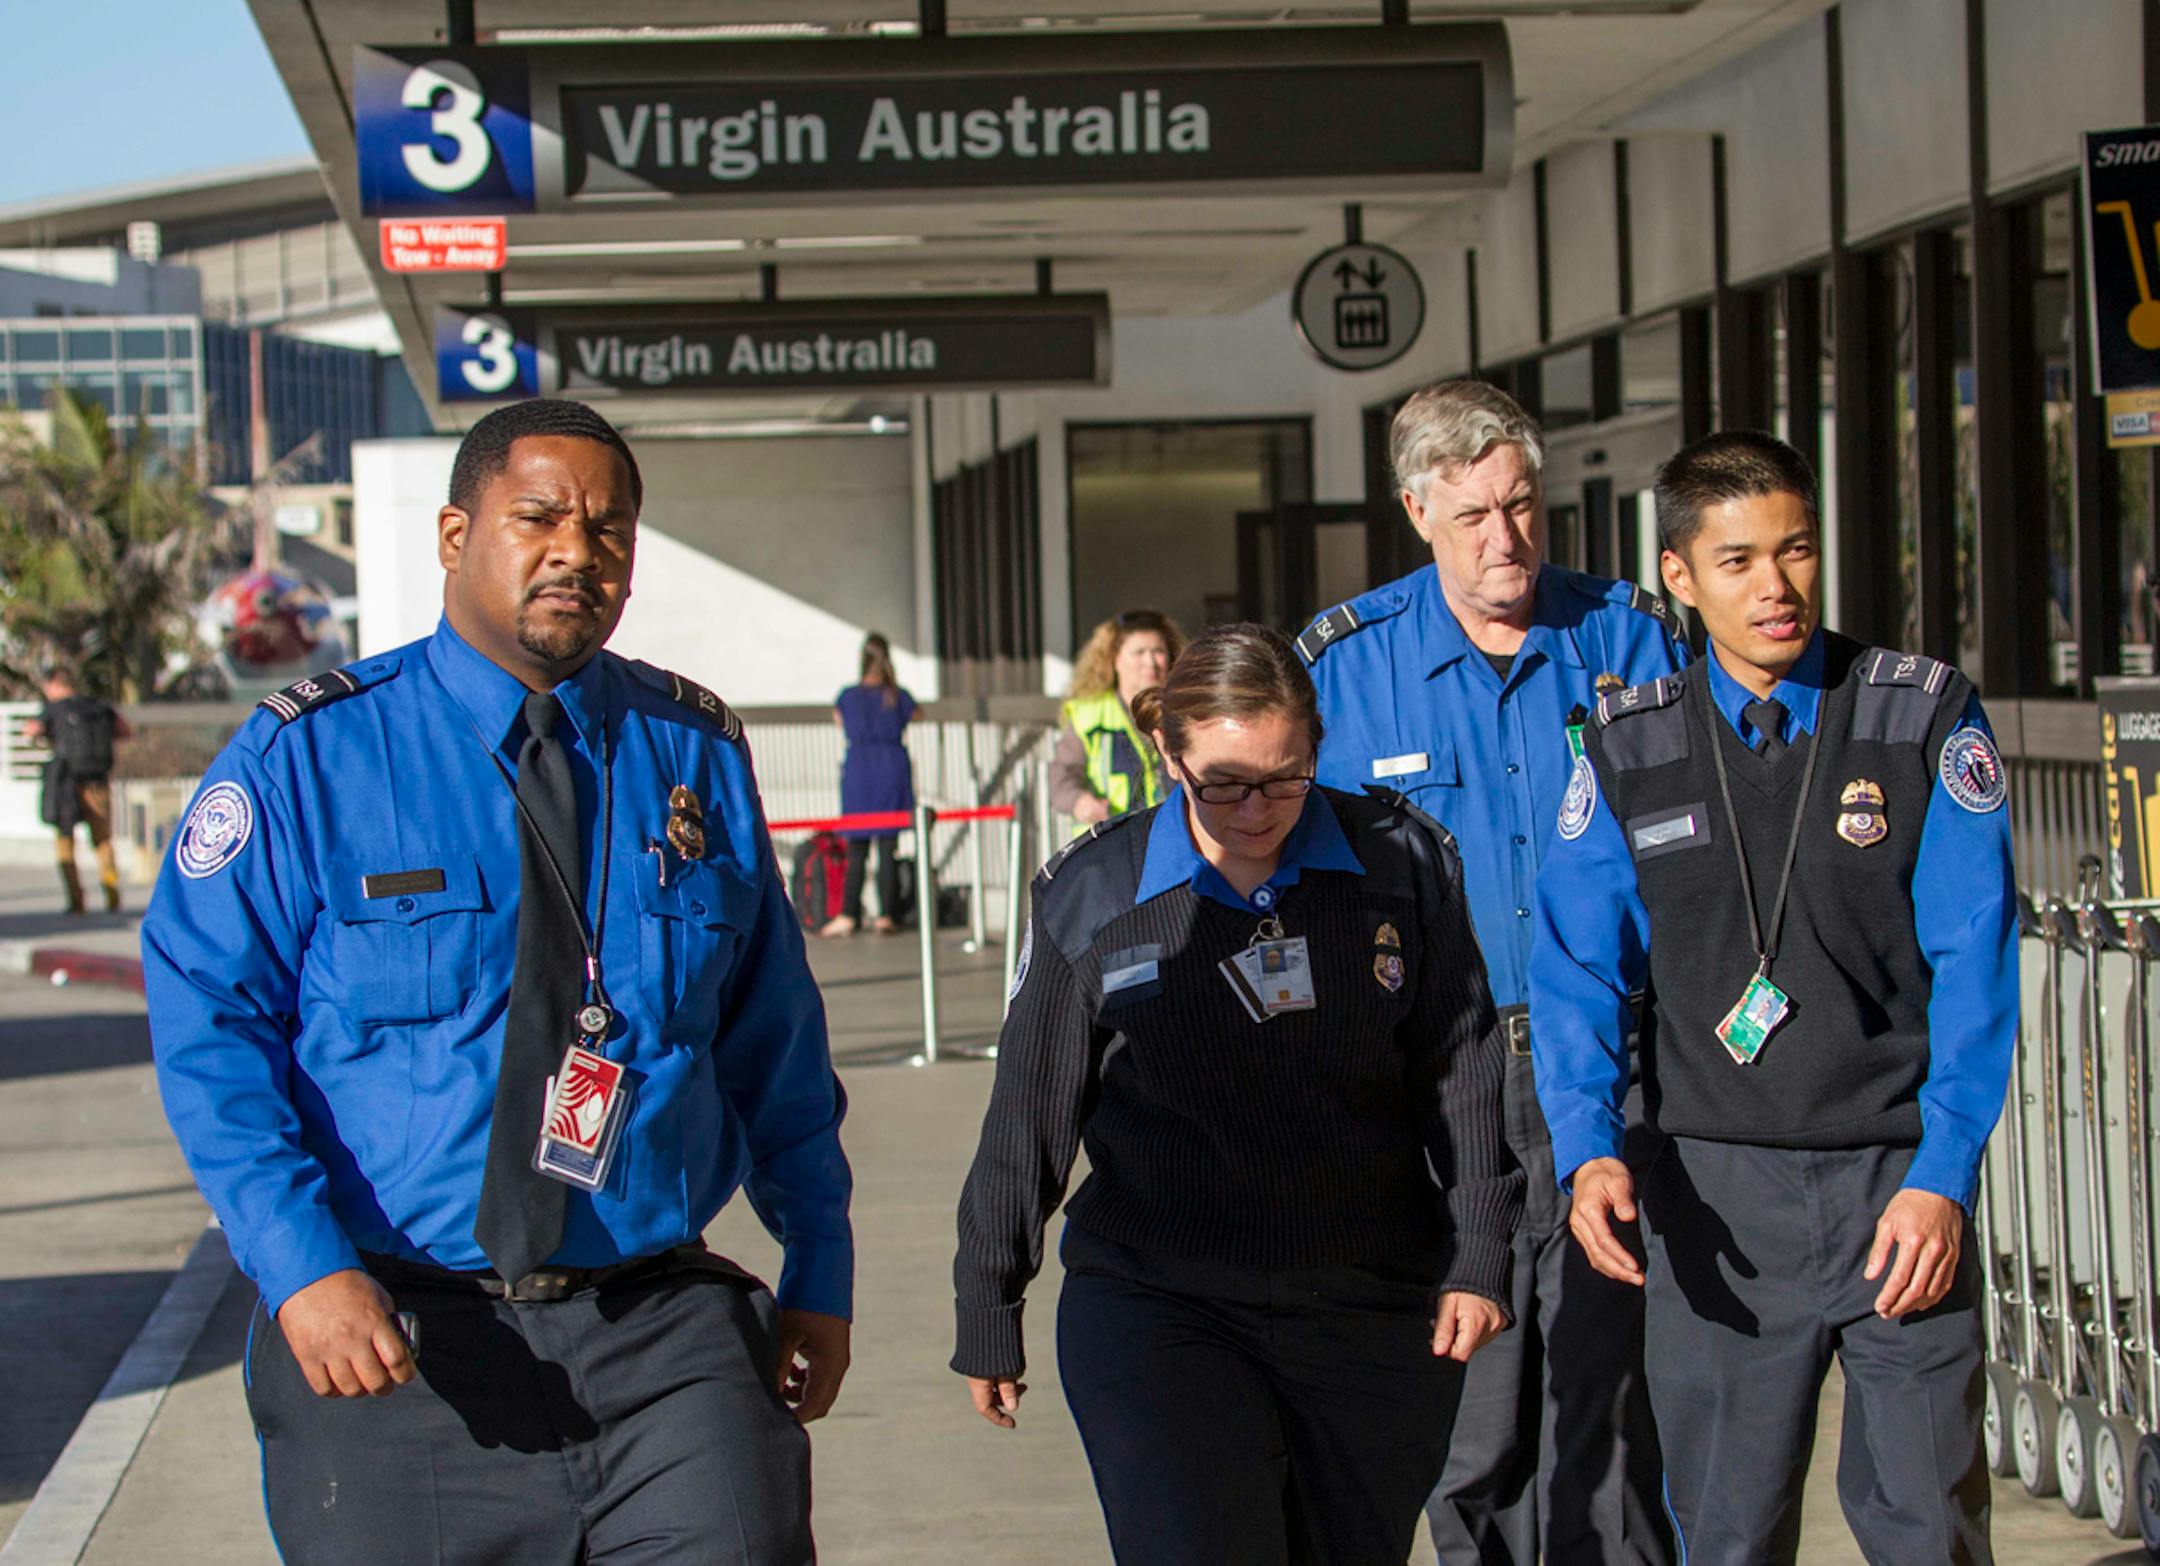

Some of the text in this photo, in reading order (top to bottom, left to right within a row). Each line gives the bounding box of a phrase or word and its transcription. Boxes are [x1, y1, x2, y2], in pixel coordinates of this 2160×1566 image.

[401, 60, 1211, 192] 3 Virgin Australia
[390, 225, 498, 248] No Waiting
[391, 247, 432, 268] Tow
[445, 246, 498, 270] Away
[461, 313, 937, 393] 3 Virgin Australia
[2116, 415, 2146, 430] VISA
[1314, 616, 1336, 642] TSA
[291, 679, 325, 702] TSA
[1620, 685, 1639, 708] TSA
